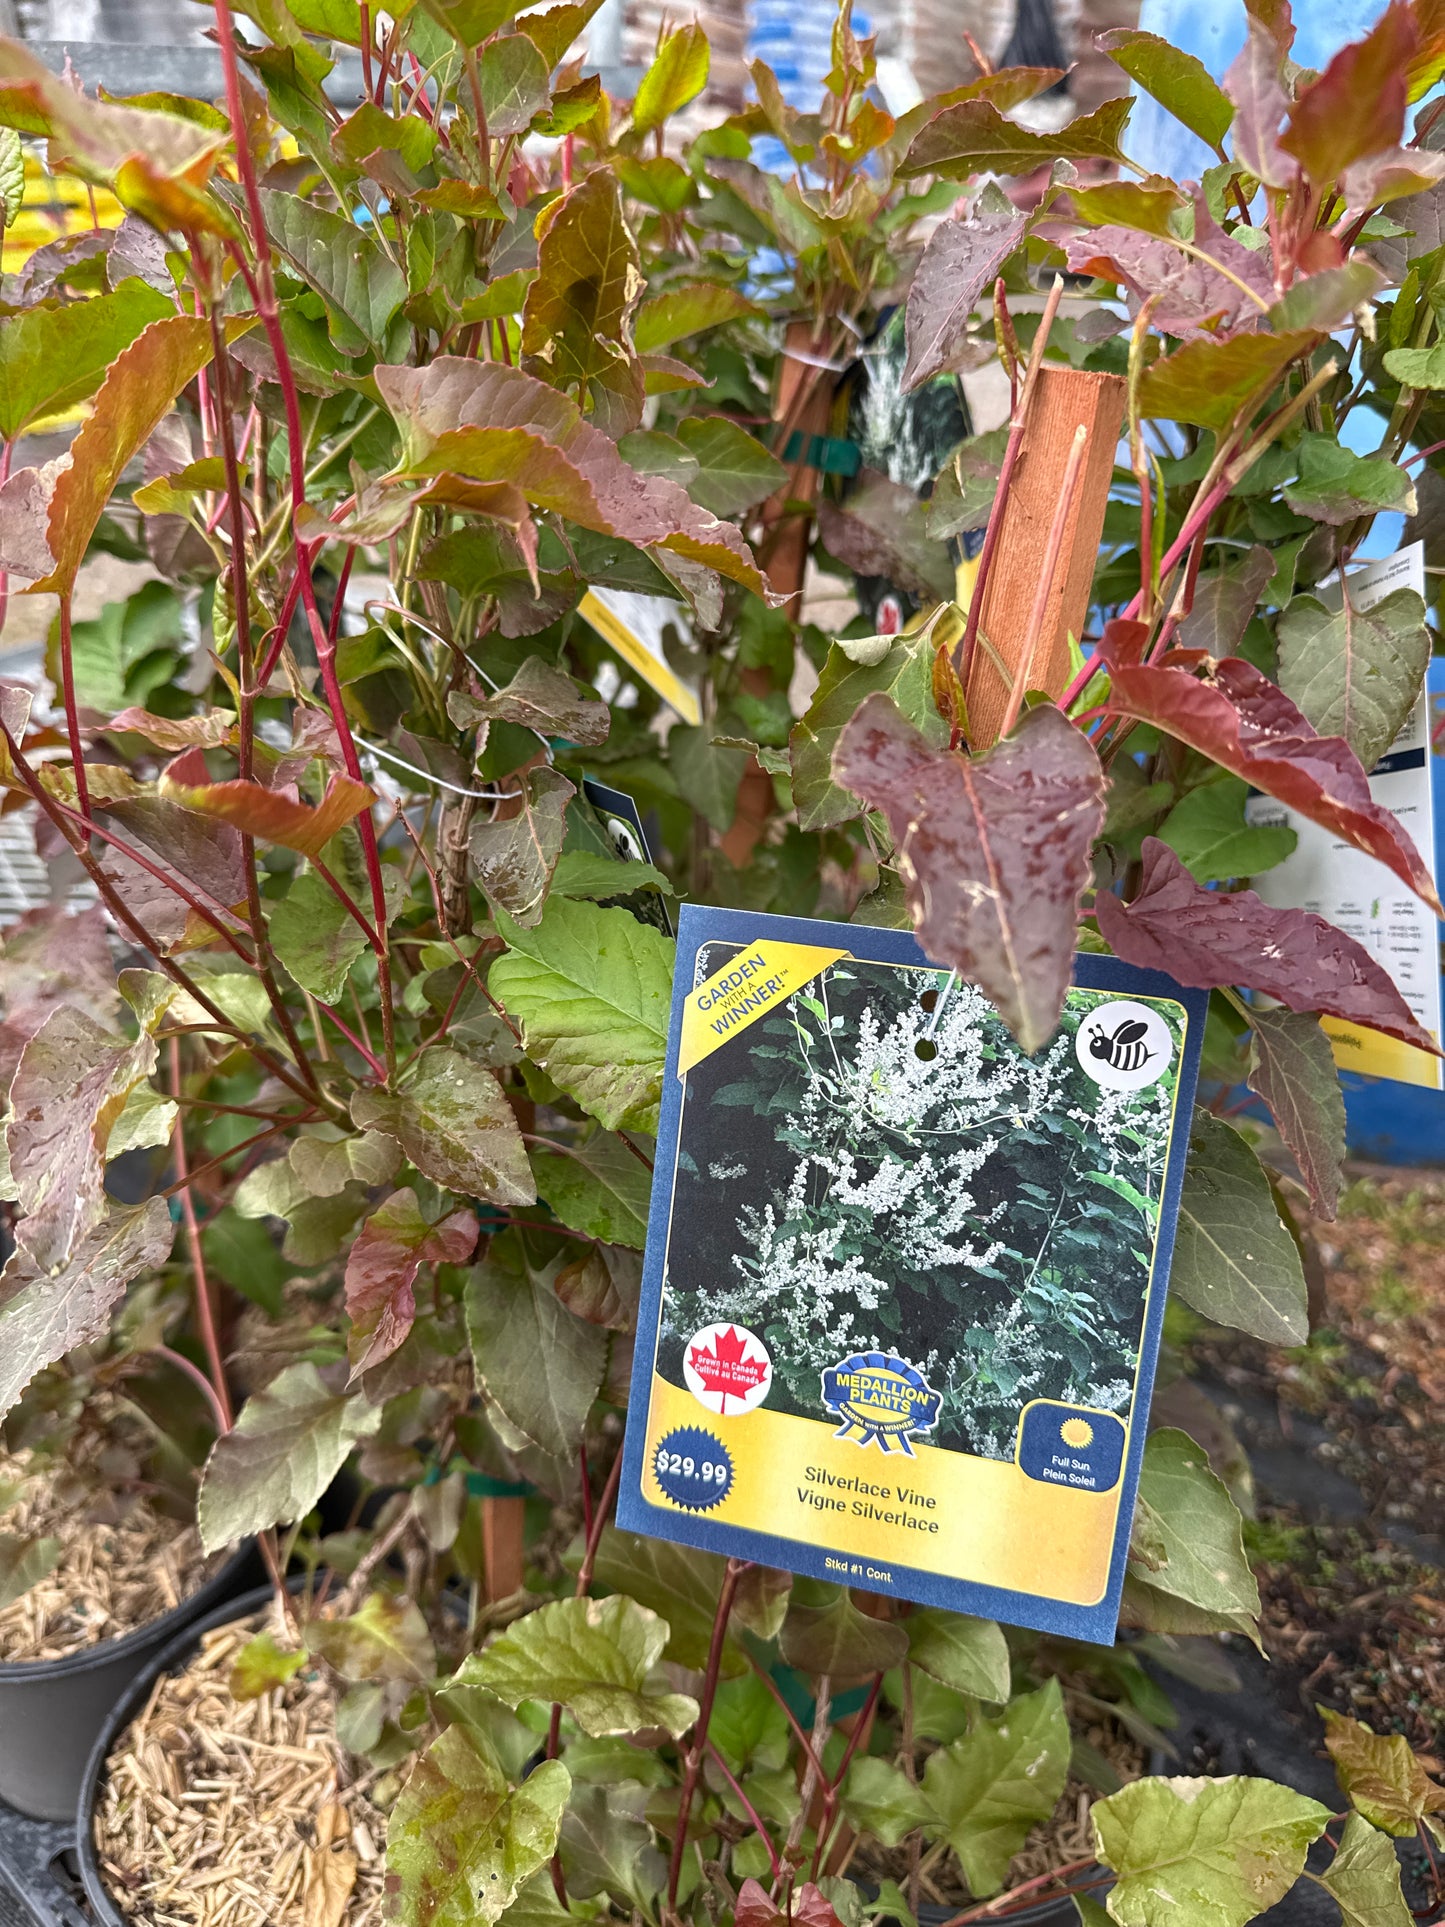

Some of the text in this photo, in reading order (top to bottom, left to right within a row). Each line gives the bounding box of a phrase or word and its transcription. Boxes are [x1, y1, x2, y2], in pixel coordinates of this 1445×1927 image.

[697, 953, 766, 1011] GARDEN
[720, 982, 757, 1010] WITH A
[694, 1363, 760, 1385] Cultivé au Canada
[697, 1354, 759, 1376] Grown in Canada
[850, 1389, 912, 1414] PLANTS
[839, 1402, 865, 1426] GARDEN
[864, 1422, 879, 1431] WITH
[656, 1448, 727, 1486] $29.99
[1051, 1455, 1091, 1471] Full Sun
[804, 1466, 937, 1509] Silverlace Vine
[1043, 1467, 1096, 1487] Plein Soleil
[797, 1487, 940, 1533] Vigne Silverlace
[824, 1557, 895, 1583] Stkd #1 Cont.
